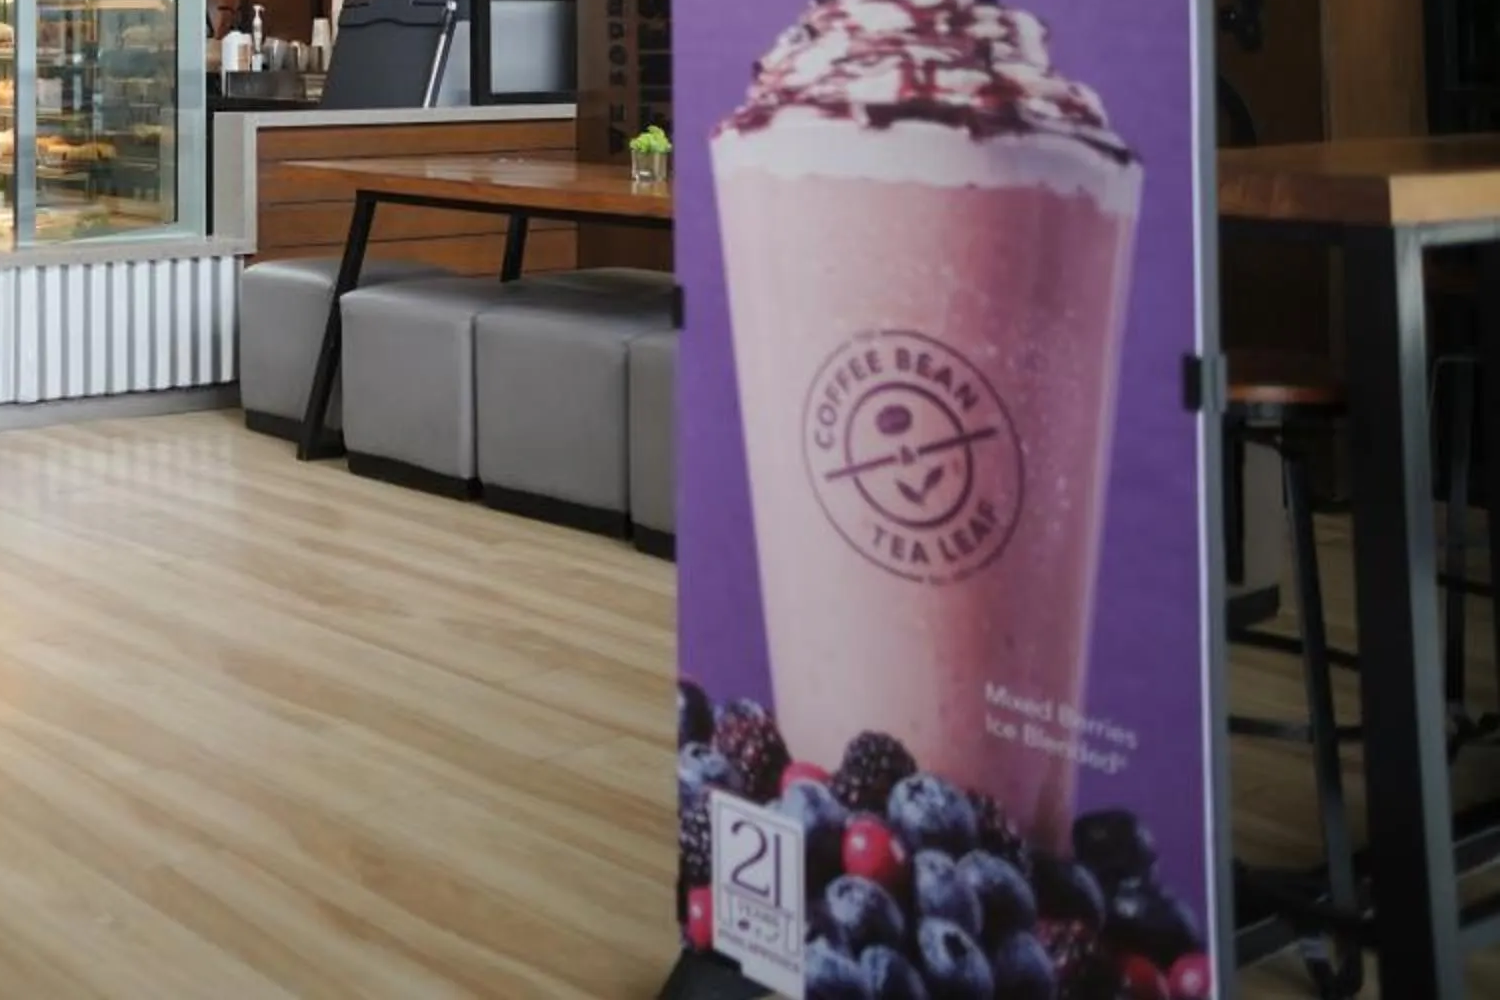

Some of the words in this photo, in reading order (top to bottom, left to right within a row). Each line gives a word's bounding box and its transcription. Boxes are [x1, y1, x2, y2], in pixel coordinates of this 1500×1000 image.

[813, 348, 883, 450] COFFEE
[894, 346, 981, 411] BEAN
[869, 523, 931, 568] TEA
[937, 501, 1005, 564] LEAF
[731, 819, 782, 909] 21
